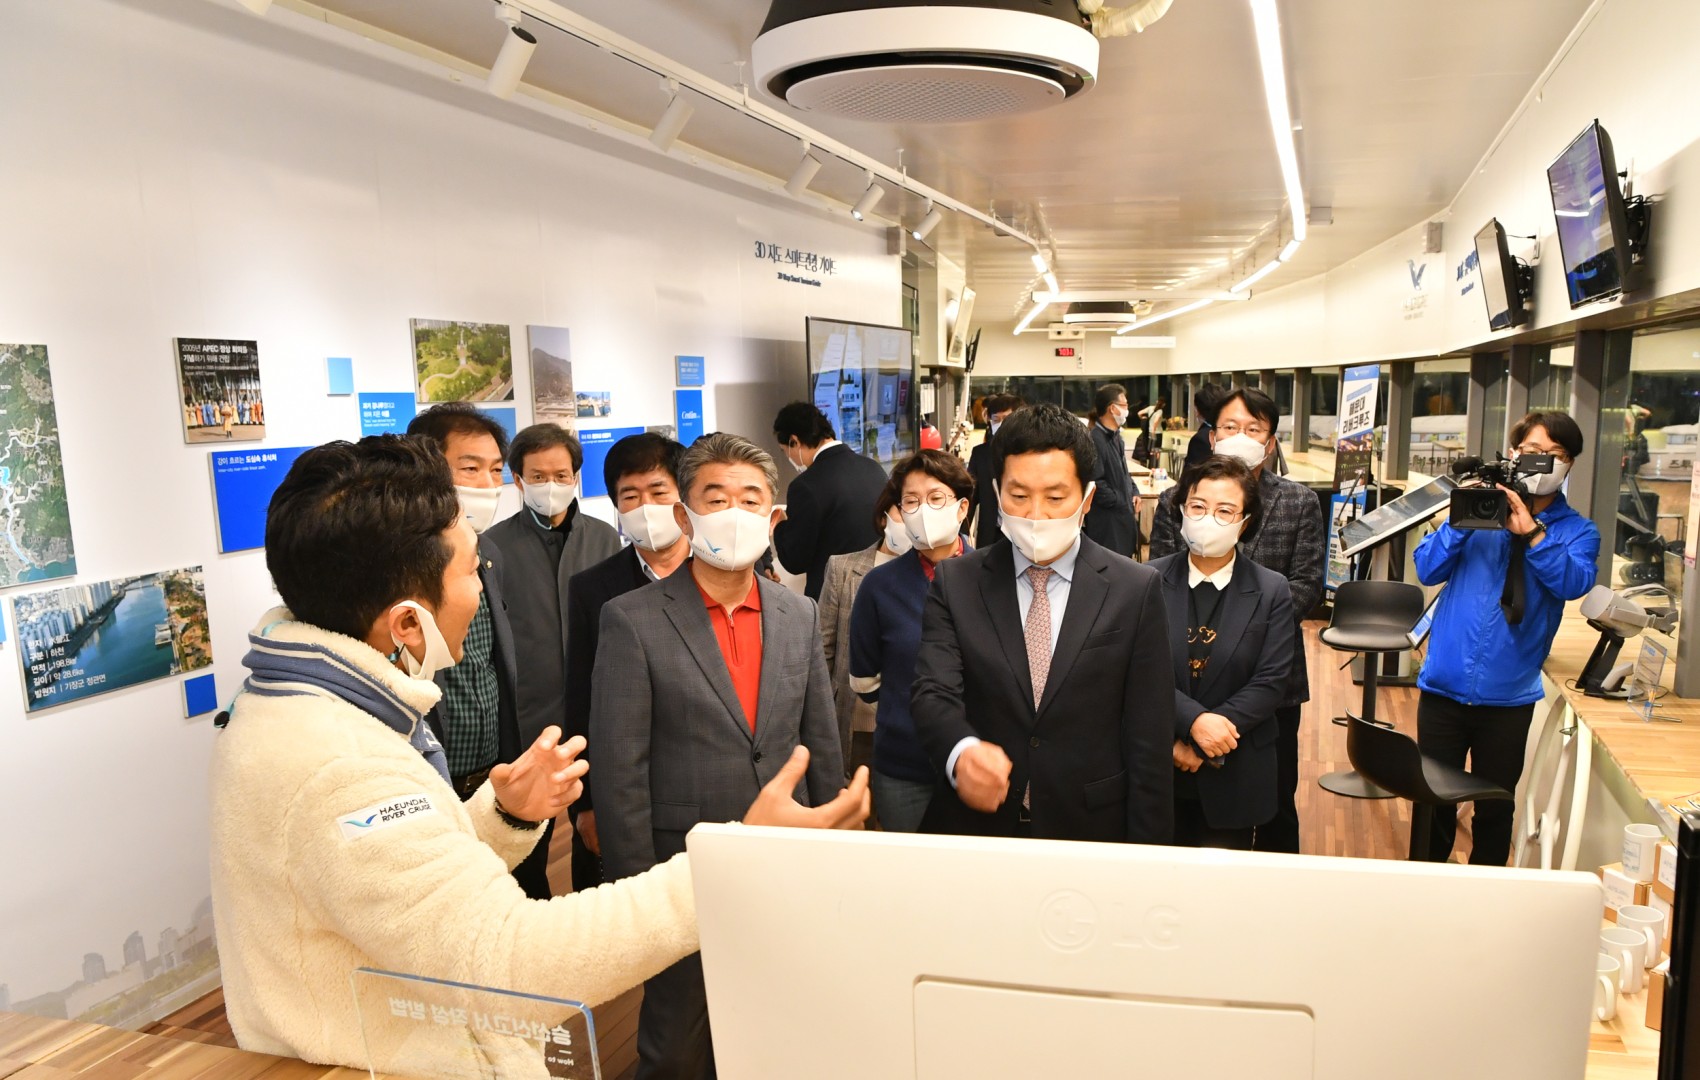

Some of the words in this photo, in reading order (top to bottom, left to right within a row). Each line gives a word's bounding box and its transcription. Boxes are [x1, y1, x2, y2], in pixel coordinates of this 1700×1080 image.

[755, 240, 766, 258] 3D
[768, 243, 782, 263] 지도
[784, 248, 818, 273] 스마트관광
[820, 255, 838, 276] 가이드
[181, 343, 201, 353] 2005년
[202, 344, 219, 353] APEC
[217, 456, 229, 466] 강이
[229, 455, 245, 465] 흐르는
[245, 454, 262, 464] 도심속
[29, 650, 44, 662] 구분
[50, 646, 65, 658] 하천
[31, 663, 46, 675] 면적
[33, 673, 48, 687] 길이
[53, 671, 61, 681] 약
[34, 685, 56, 699] 발원지
[65, 679, 85, 691] 기장군
[86, 673, 107, 686] 정관면
[379, 797, 428, 816] HAEUNDAE
[381, 810, 406, 823] RIVER
[408, 803, 432, 815] CRUISE
[1110, 901, 1181, 952] LG
